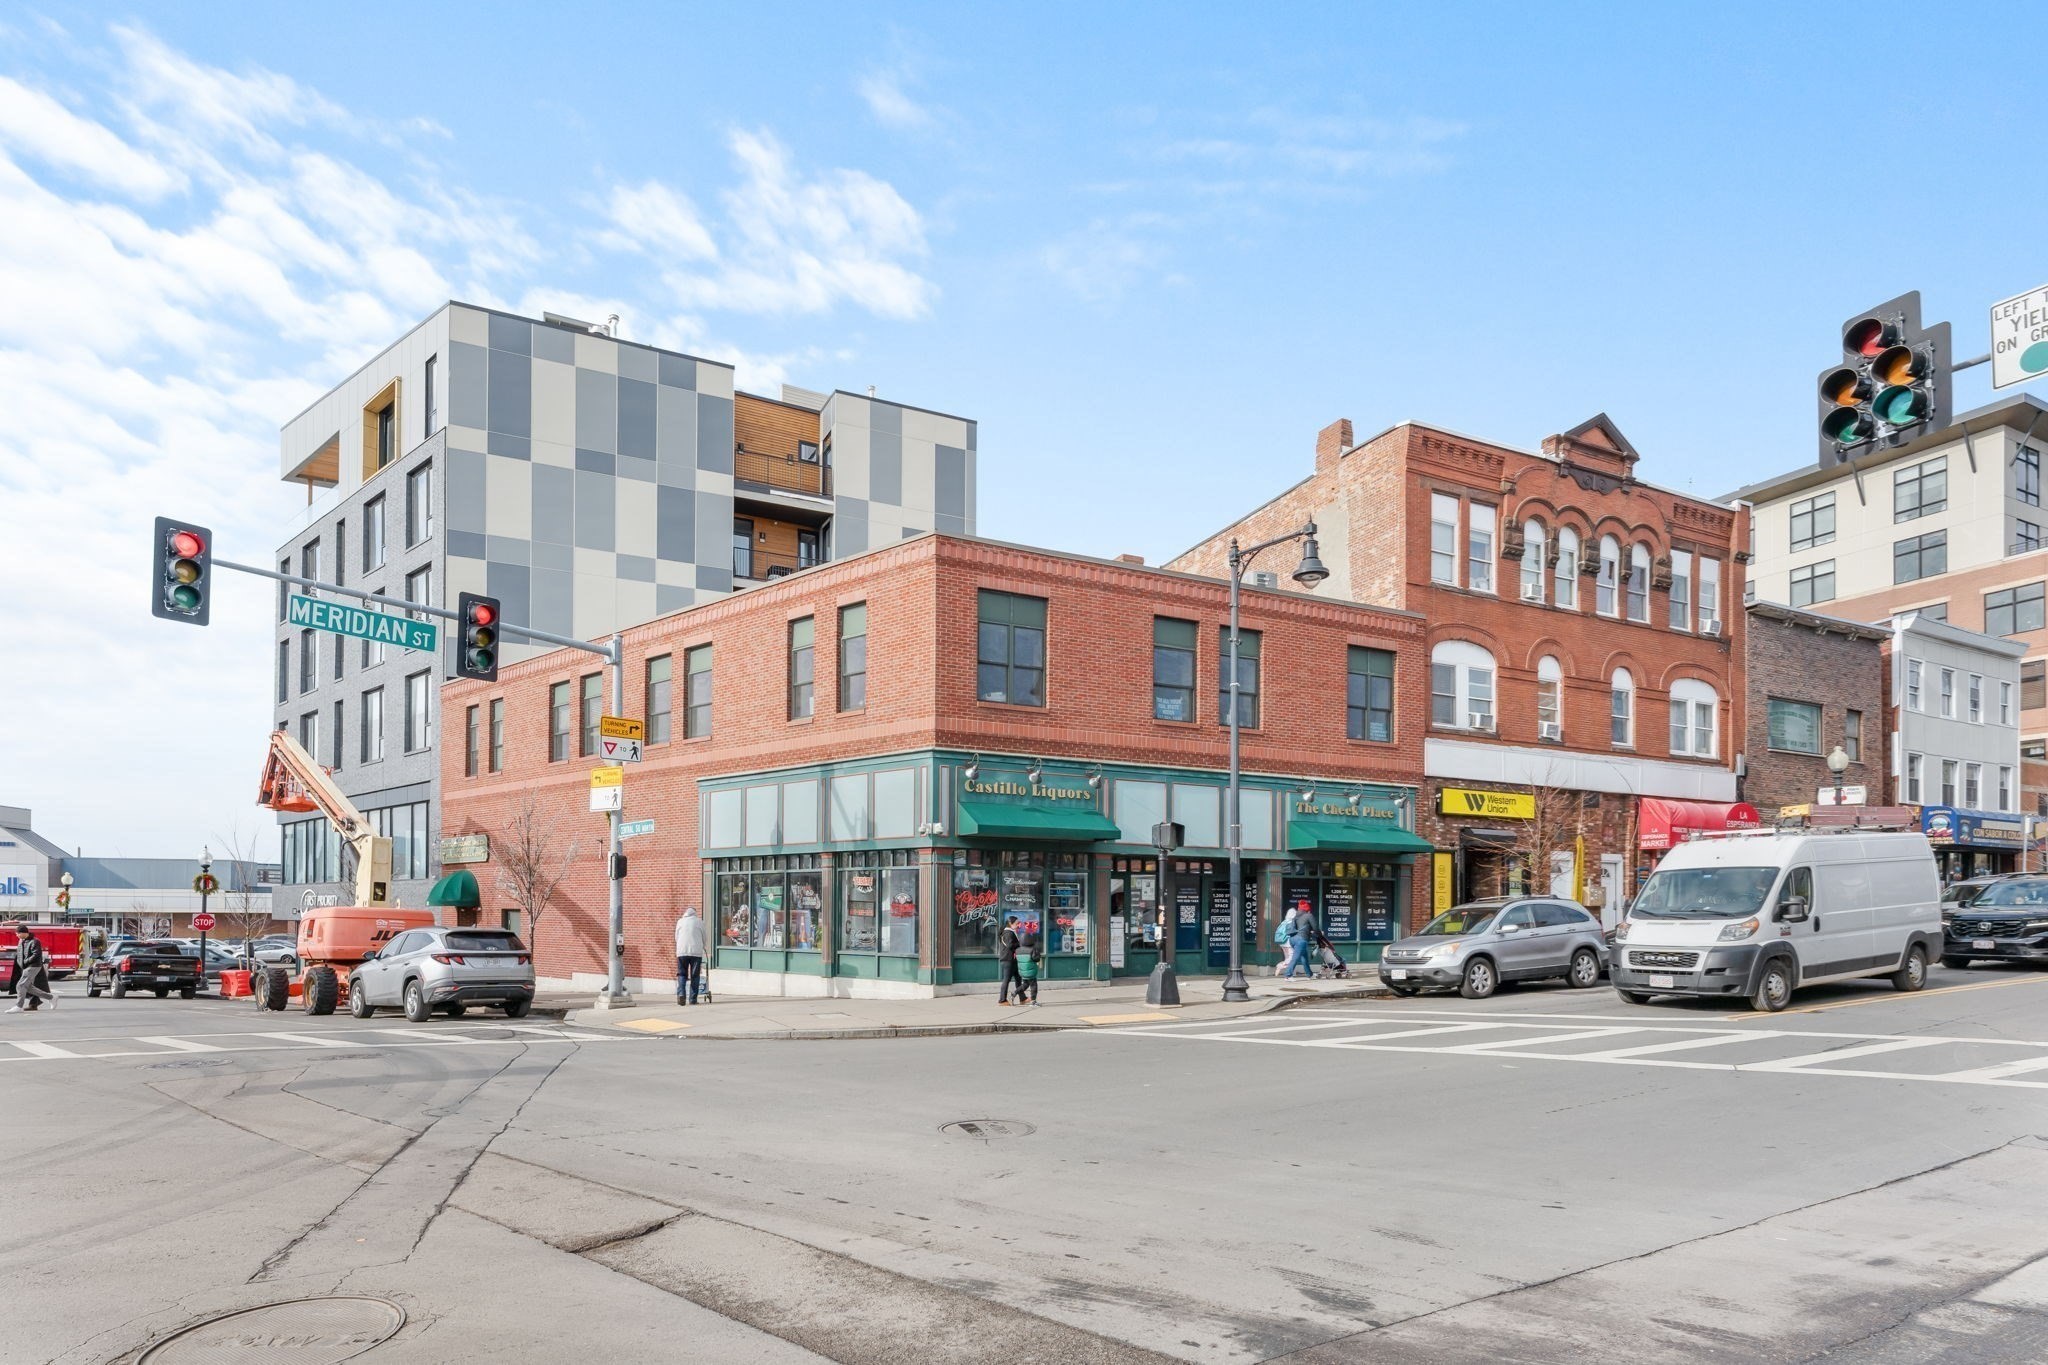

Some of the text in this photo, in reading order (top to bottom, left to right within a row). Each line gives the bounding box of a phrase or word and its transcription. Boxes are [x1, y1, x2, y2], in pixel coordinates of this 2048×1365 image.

[1994, 298, 2029, 321] LEFT
[1996, 336, 2017, 354] ON
[291, 599, 431, 647] MERIDIAN ST
[604, 728, 629, 736] VEHICLES
[964, 780, 1091, 801] Castillo Liquors
[1487, 794, 1517, 806] Western
[1296, 802, 1394, 819] The Check Place
[1487, 804, 1509, 814] Union
[1739, 811, 1748, 820] LA
[1972, 828, 1984, 837] CON
[1985, 829, 2002, 838] SABOR
[1641, 840, 1669, 848] MARKET
[1246, 884, 1252, 898] SF
[958, 904, 998, 926] LIGHT
[194, 918, 214, 926] STOP
